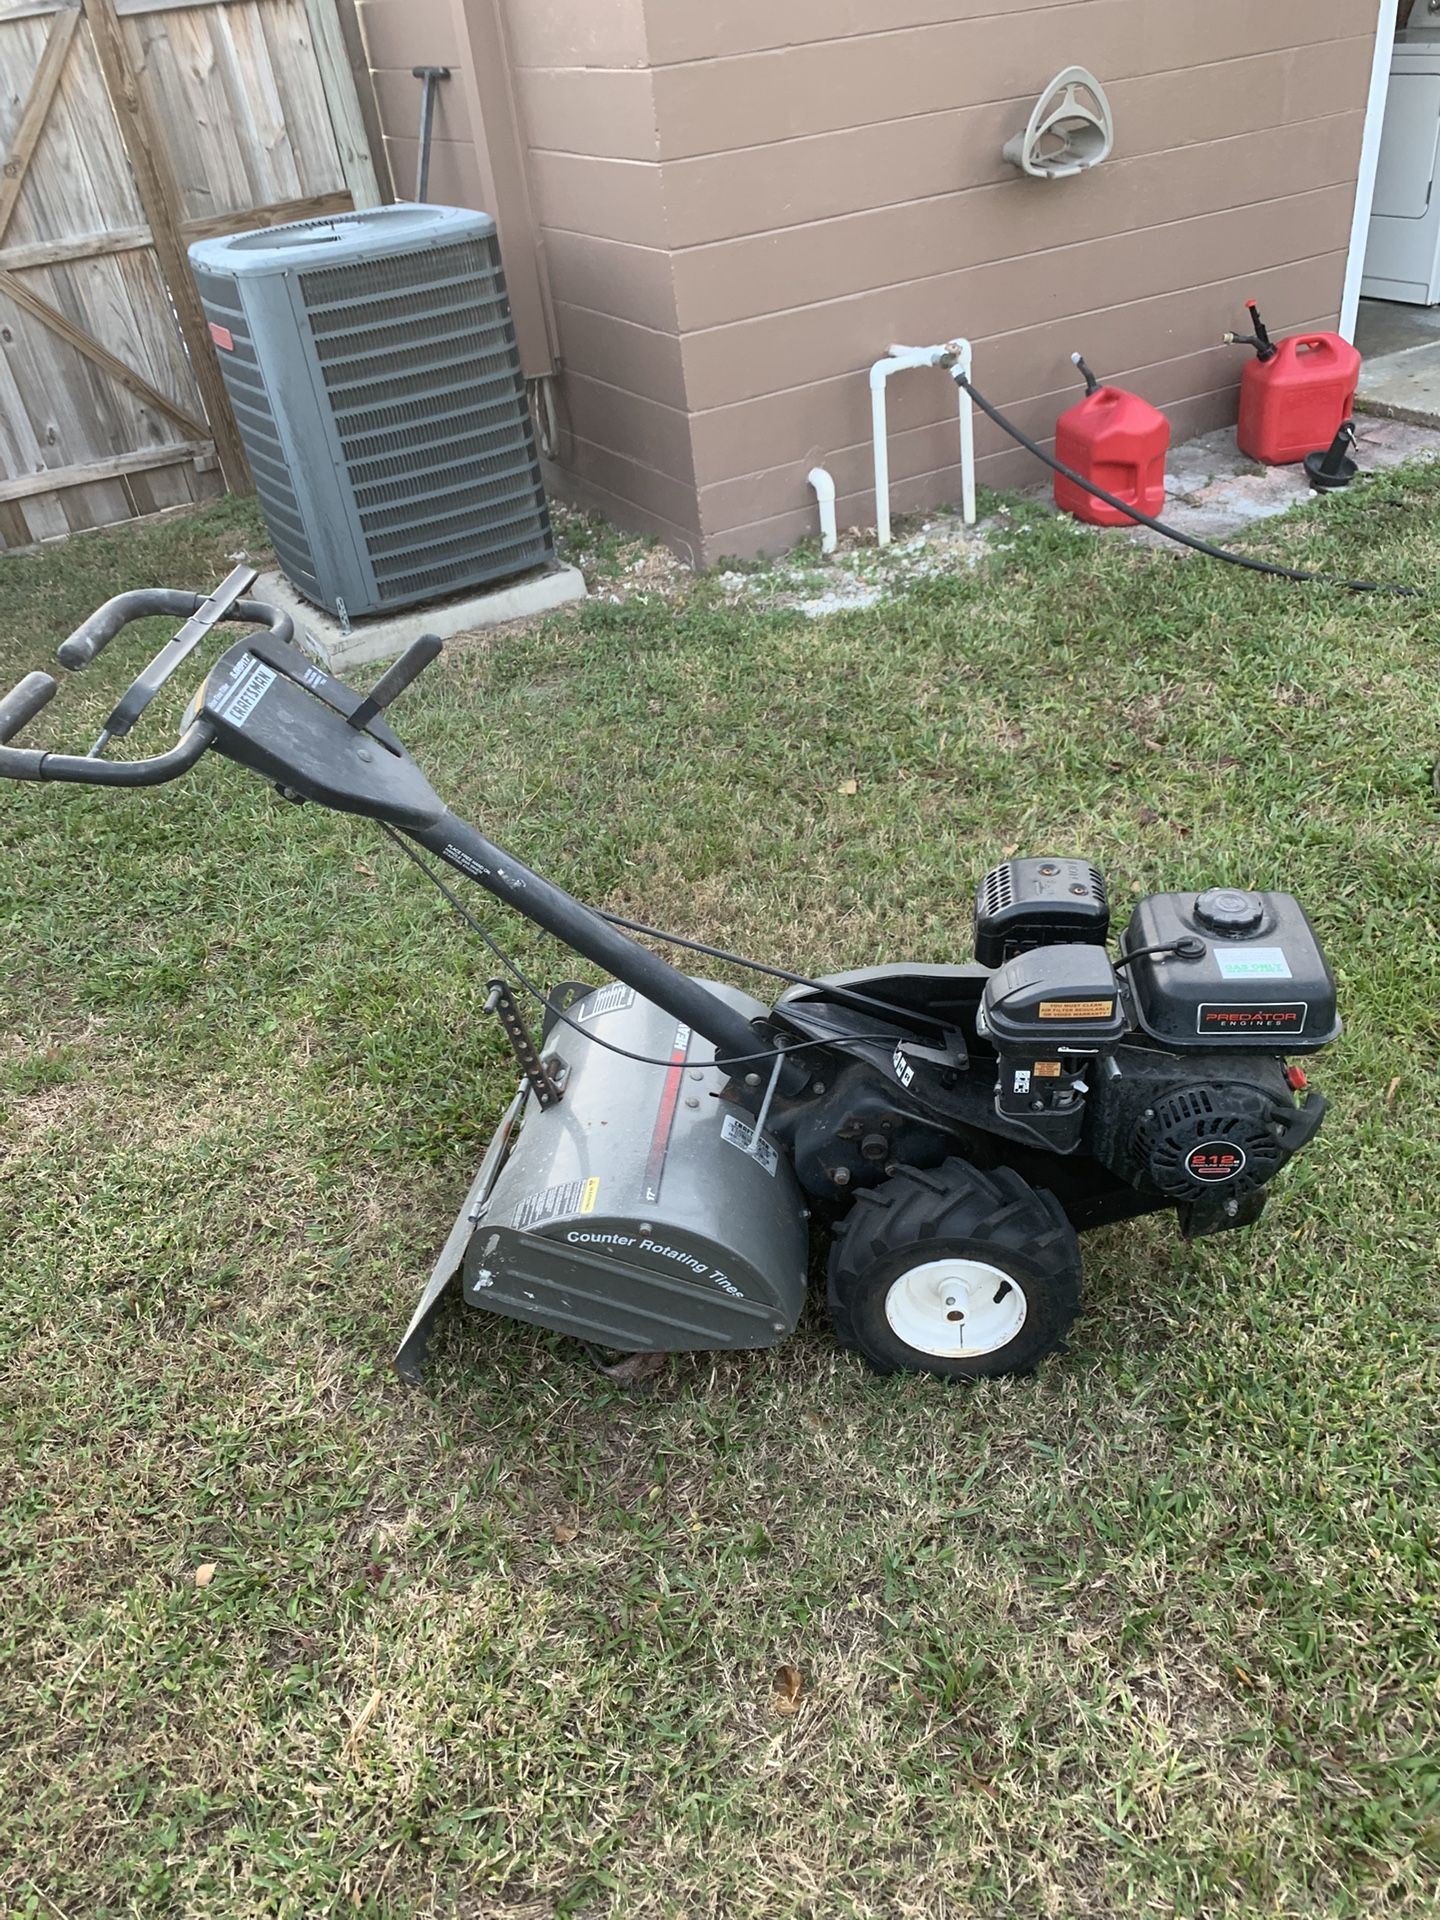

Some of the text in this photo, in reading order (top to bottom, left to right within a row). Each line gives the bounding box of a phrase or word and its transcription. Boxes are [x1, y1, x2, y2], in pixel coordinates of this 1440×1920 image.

[229, 670, 271, 720] CRAFTSMAN
[1206, 1013, 1297, 1021] PREDATOR
[734, 1121, 769, 1149] CRAFTMAN
[1192, 1155, 1234, 1164] 212
[567, 1231, 745, 1299] Counter Rotating Tines
